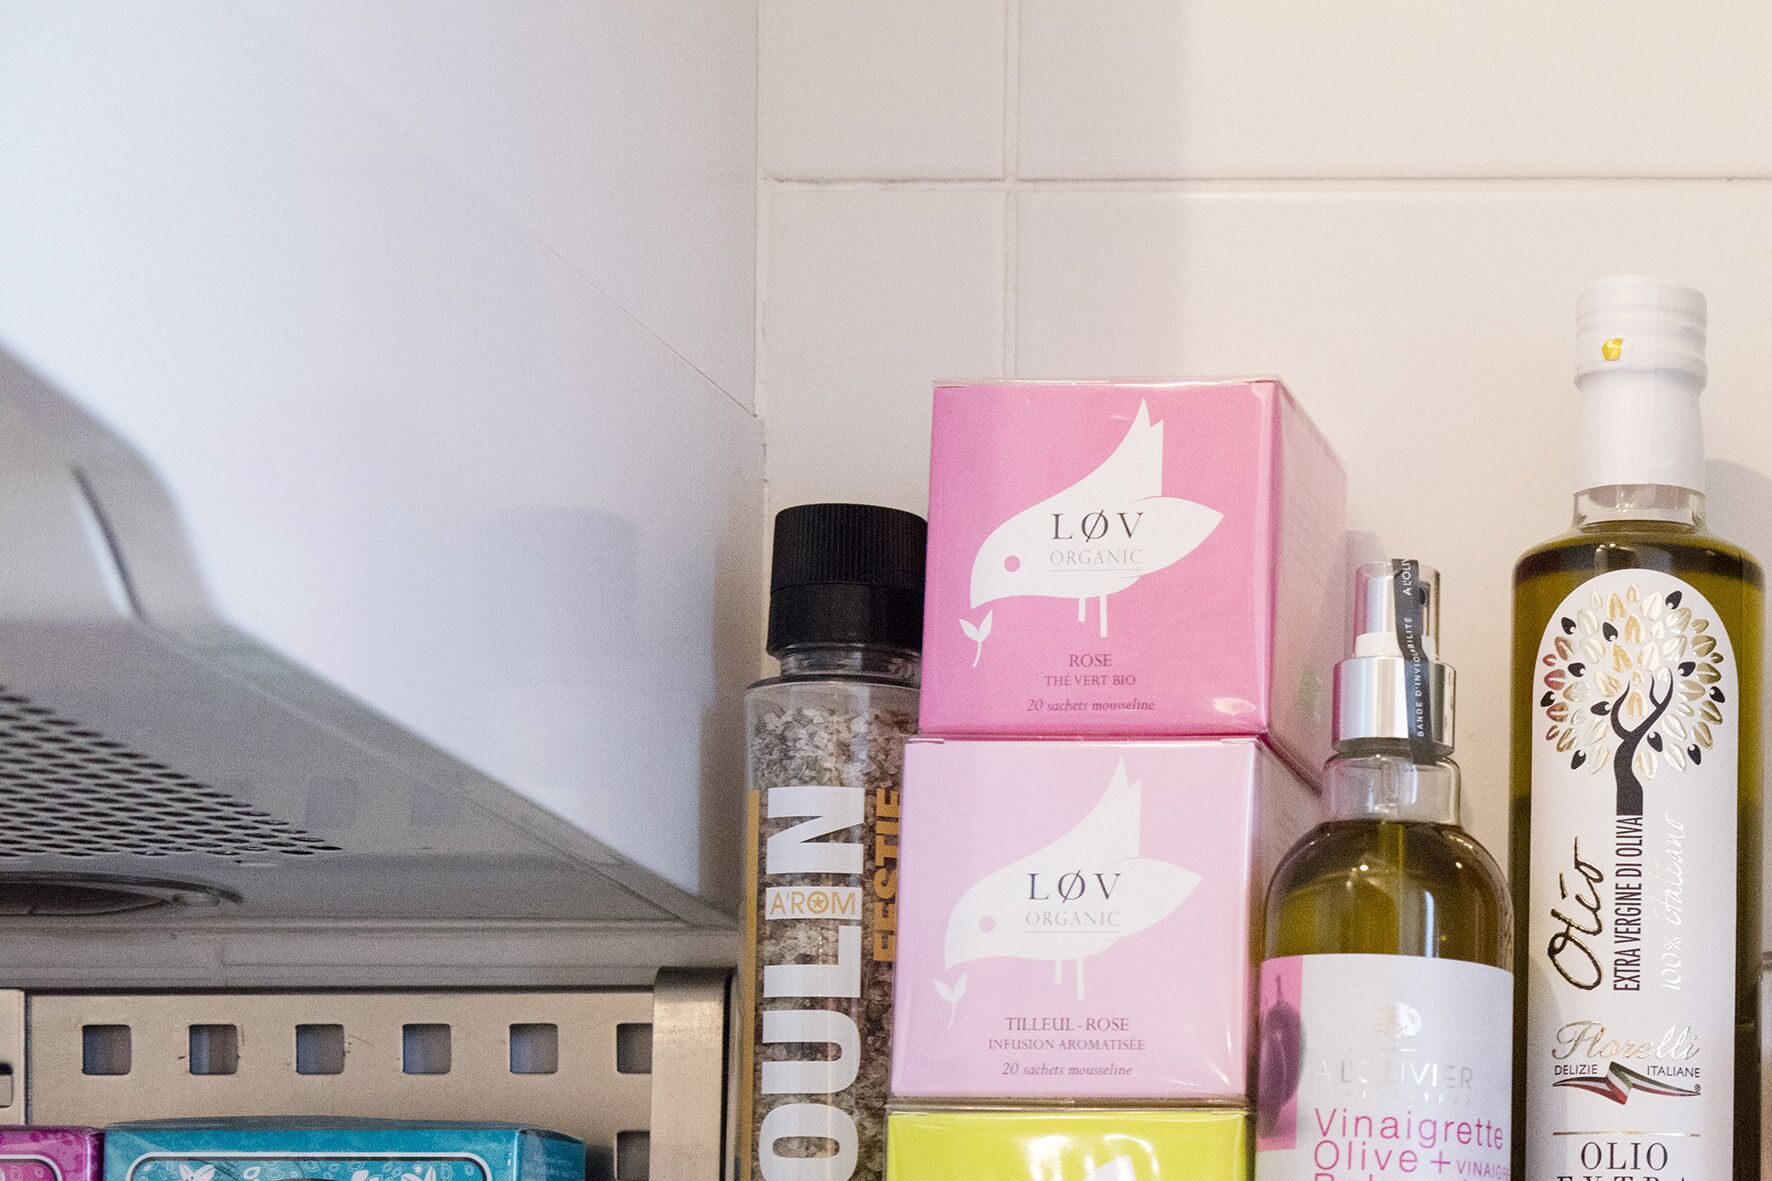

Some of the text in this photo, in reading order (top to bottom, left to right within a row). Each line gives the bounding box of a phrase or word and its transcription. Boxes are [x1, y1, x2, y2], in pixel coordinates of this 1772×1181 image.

[1052, 509, 1144, 543] LØV
[1050, 549, 1143, 565] ORGANIC
[1069, 653, 1113, 667] ROSE
[1044, 672, 1137, 686] THÉ VERT BIO
[1404, 616, 1425, 738] BANDE D'INVIOLABILITÉ
[1027, 698, 1155, 712] 20 sachets mousseline
[1027, 869, 1122, 904] LØV
[1613, 814, 1644, 992] EXTRA VERGINE DI OLIVA
[1650, 809, 1687, 991] 100% italiano
[1025, 911, 1121, 927] ORGANIC
[1548, 836, 1605, 991] Olio
[1005, 1017, 1130, 1032] TILLEUL ROSE
[988, 1036, 1146, 1051] INFUSION AROMATISÉE
[1002, 1062, 1133, 1076] 20 sachets mousseline
[1554, 1063, 1701, 1079] DELIZIE ITALIANE
[1314, 1107, 1504, 1150] Vinaigrette
[1313, 1139, 1452, 1175] Olive +
[1580, 1141, 1669, 1171] OLIO
